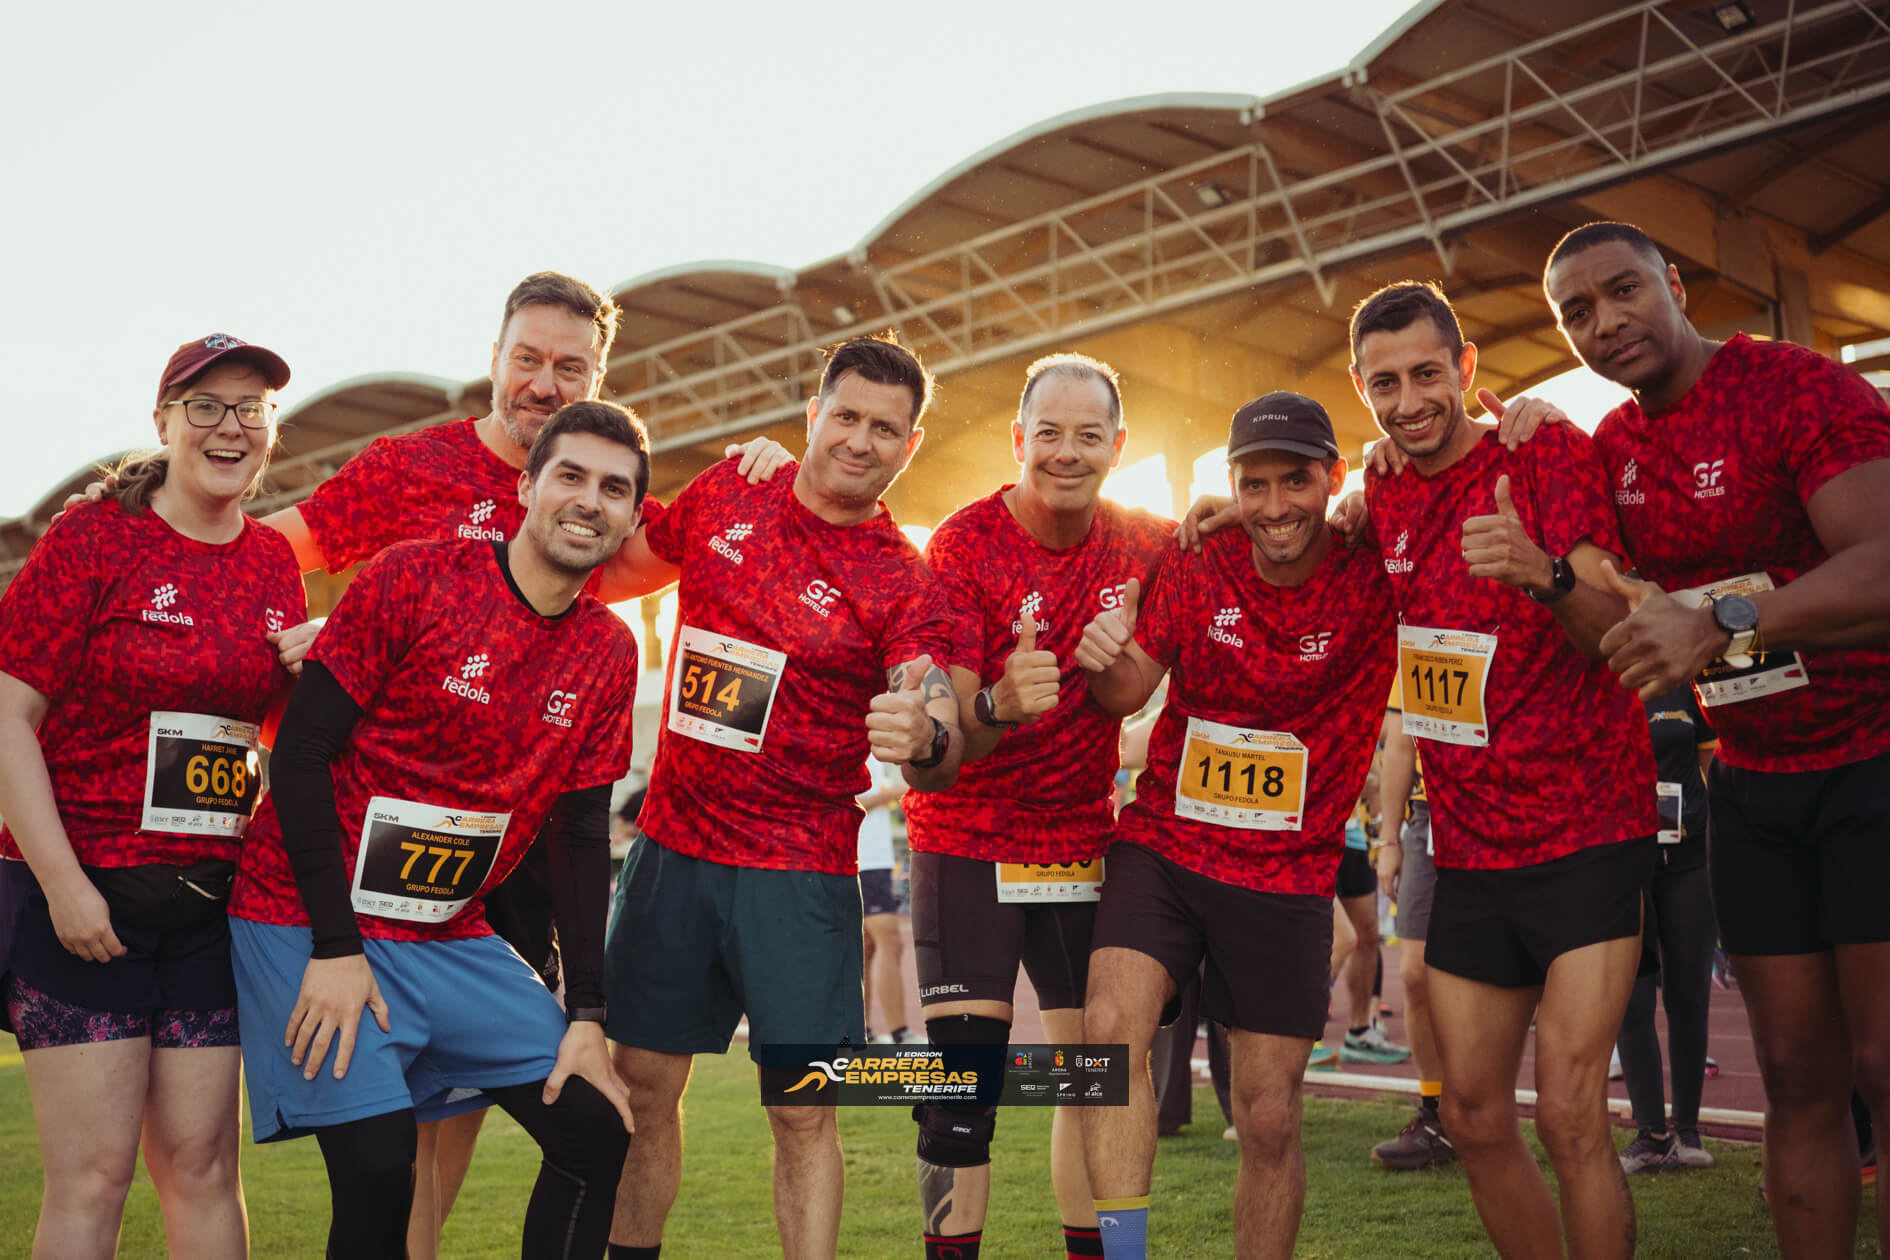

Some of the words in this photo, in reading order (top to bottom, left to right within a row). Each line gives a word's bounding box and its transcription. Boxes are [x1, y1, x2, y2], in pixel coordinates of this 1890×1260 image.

[1253, 413, 1288, 423] KIPRUN
[1693, 459, 1725, 488] GF
[1694, 486, 1725, 500] HOTELES
[458, 524, 504, 542] fedola
[708, 535, 744, 565] fedola
[806, 579, 842, 606] GF
[797, 593, 831, 617] HOTELES
[142, 609, 194, 627] fedola
[1012, 618, 1050, 635] feola
[1299, 631, 1332, 653] GF
[442, 675, 491, 705] fedola
[682, 664, 743, 712] 514
[1411, 664, 1469, 707] 1117
[547, 690, 577, 716] GF
[699, 703, 722, 718] FEDOLA
[542, 713, 572, 728] HOTELES
[186, 754, 247, 799] 668
[1198, 756, 1284, 798] 1118
[196, 795, 218, 805] GRUPO
[1213, 792, 1234, 802] GRUPO
[411, 831, 452, 844] ALEXANDER
[453, 838, 470, 846] COLE
[400, 841, 475, 886] 777
[406, 882, 430, 894] GRUPO
[430, 885, 454, 896] FEDOLA
[920, 984, 969, 998] LURBEL
